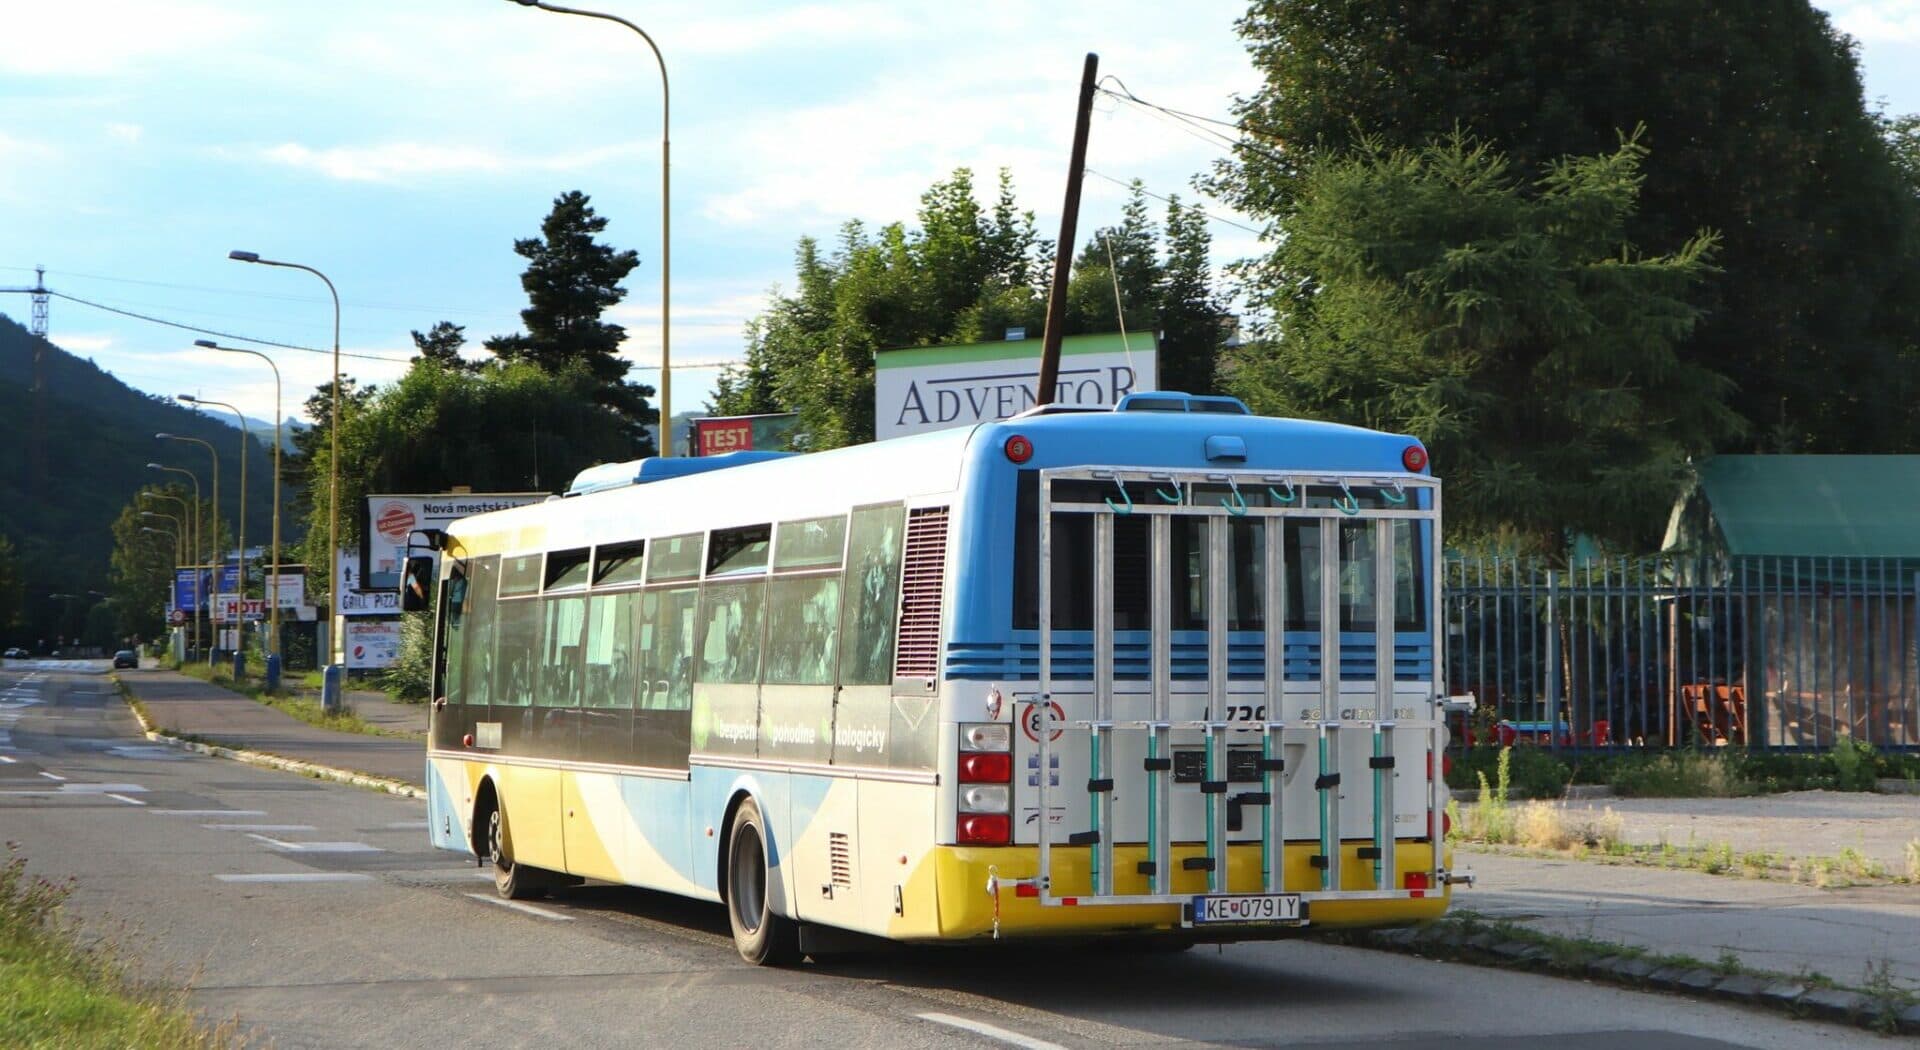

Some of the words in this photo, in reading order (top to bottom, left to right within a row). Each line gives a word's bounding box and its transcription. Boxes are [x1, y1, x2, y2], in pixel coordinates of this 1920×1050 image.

[896, 365, 1138, 426] ADVENTOR
[703, 427, 748, 448] TEST
[423, 503, 454, 515] Nová
[456, 500, 510, 514] mestská
[227, 601, 266, 614] HOTE
[1300, 708, 1322, 720] SO
[1341, 708, 1376, 720] CITY
